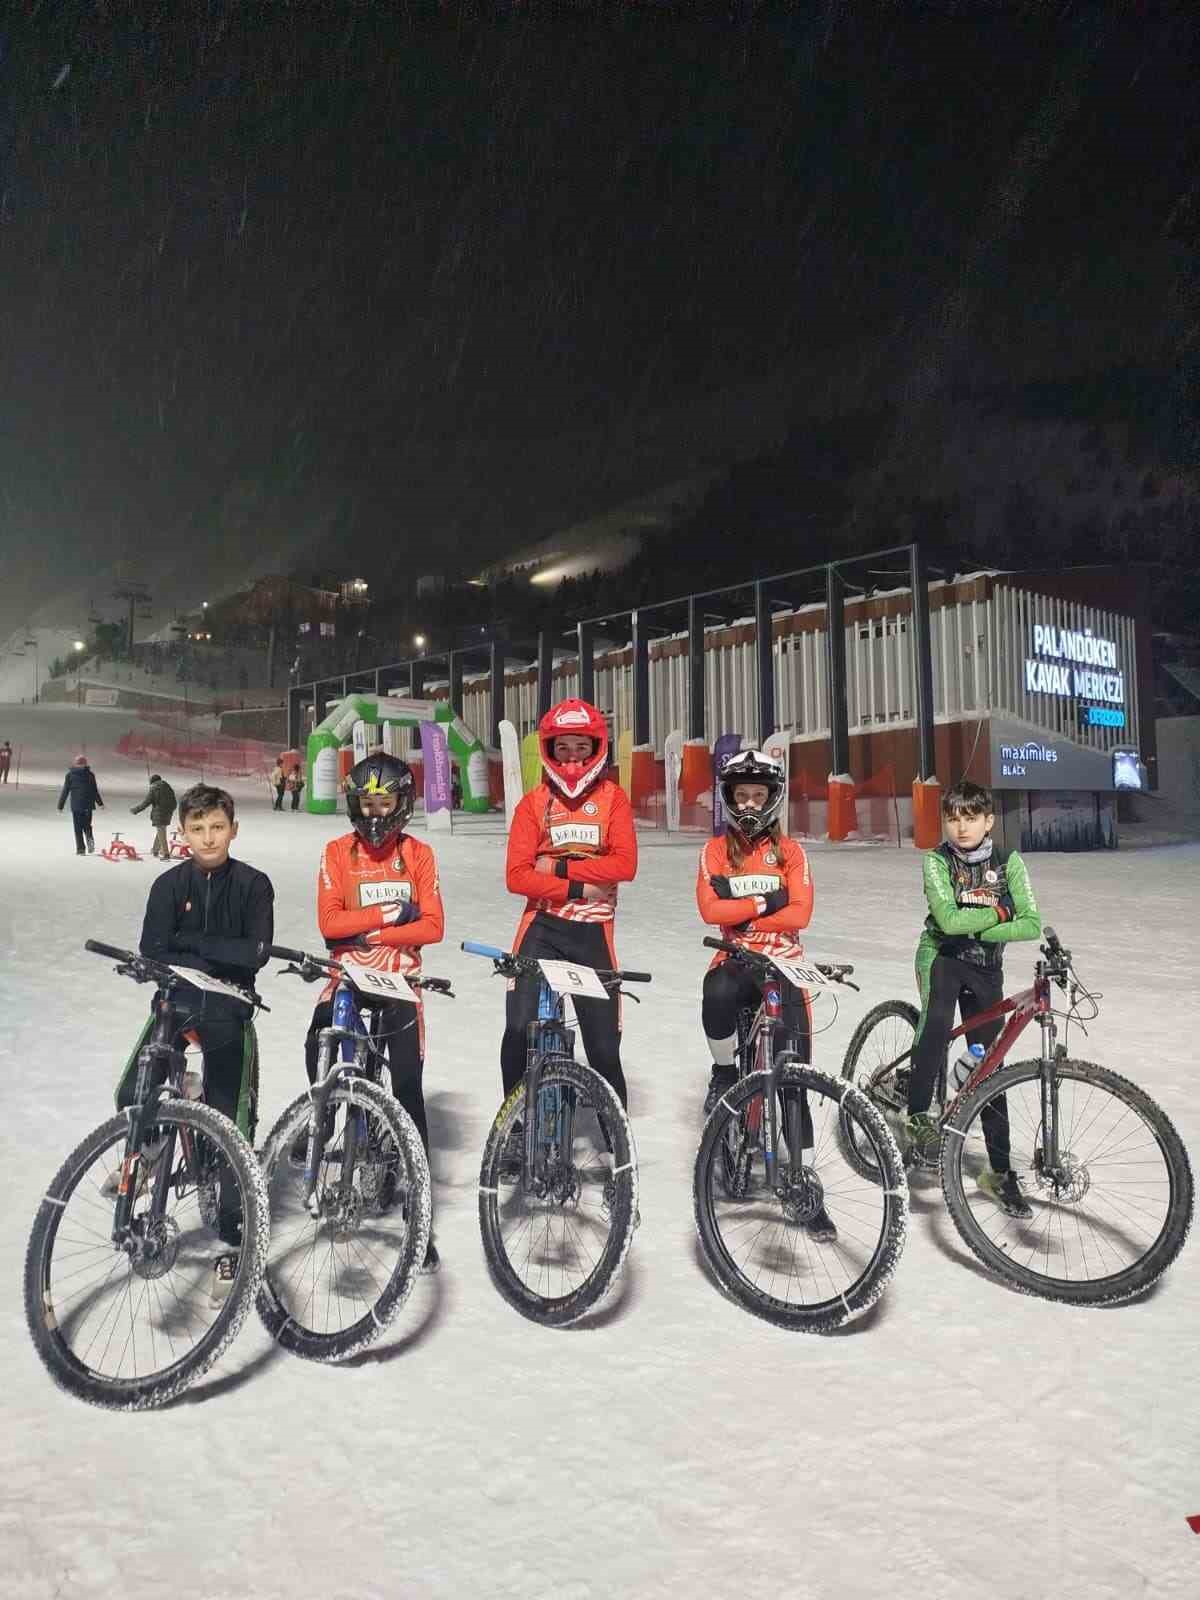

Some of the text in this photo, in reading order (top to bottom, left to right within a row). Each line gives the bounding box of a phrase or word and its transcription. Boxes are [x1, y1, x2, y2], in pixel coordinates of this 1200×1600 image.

[1034, 625, 1116, 668] PALANDÖKEN
[1026, 660, 1124, 703] KAYAK MERKEZİ
[1002, 744, 1057, 761] maximiles
[1003, 765, 1026, 776] BLACK
[365, 973, 398, 990] 99
[566, 970, 583, 986] 9
[784, 966, 826, 984] 100
